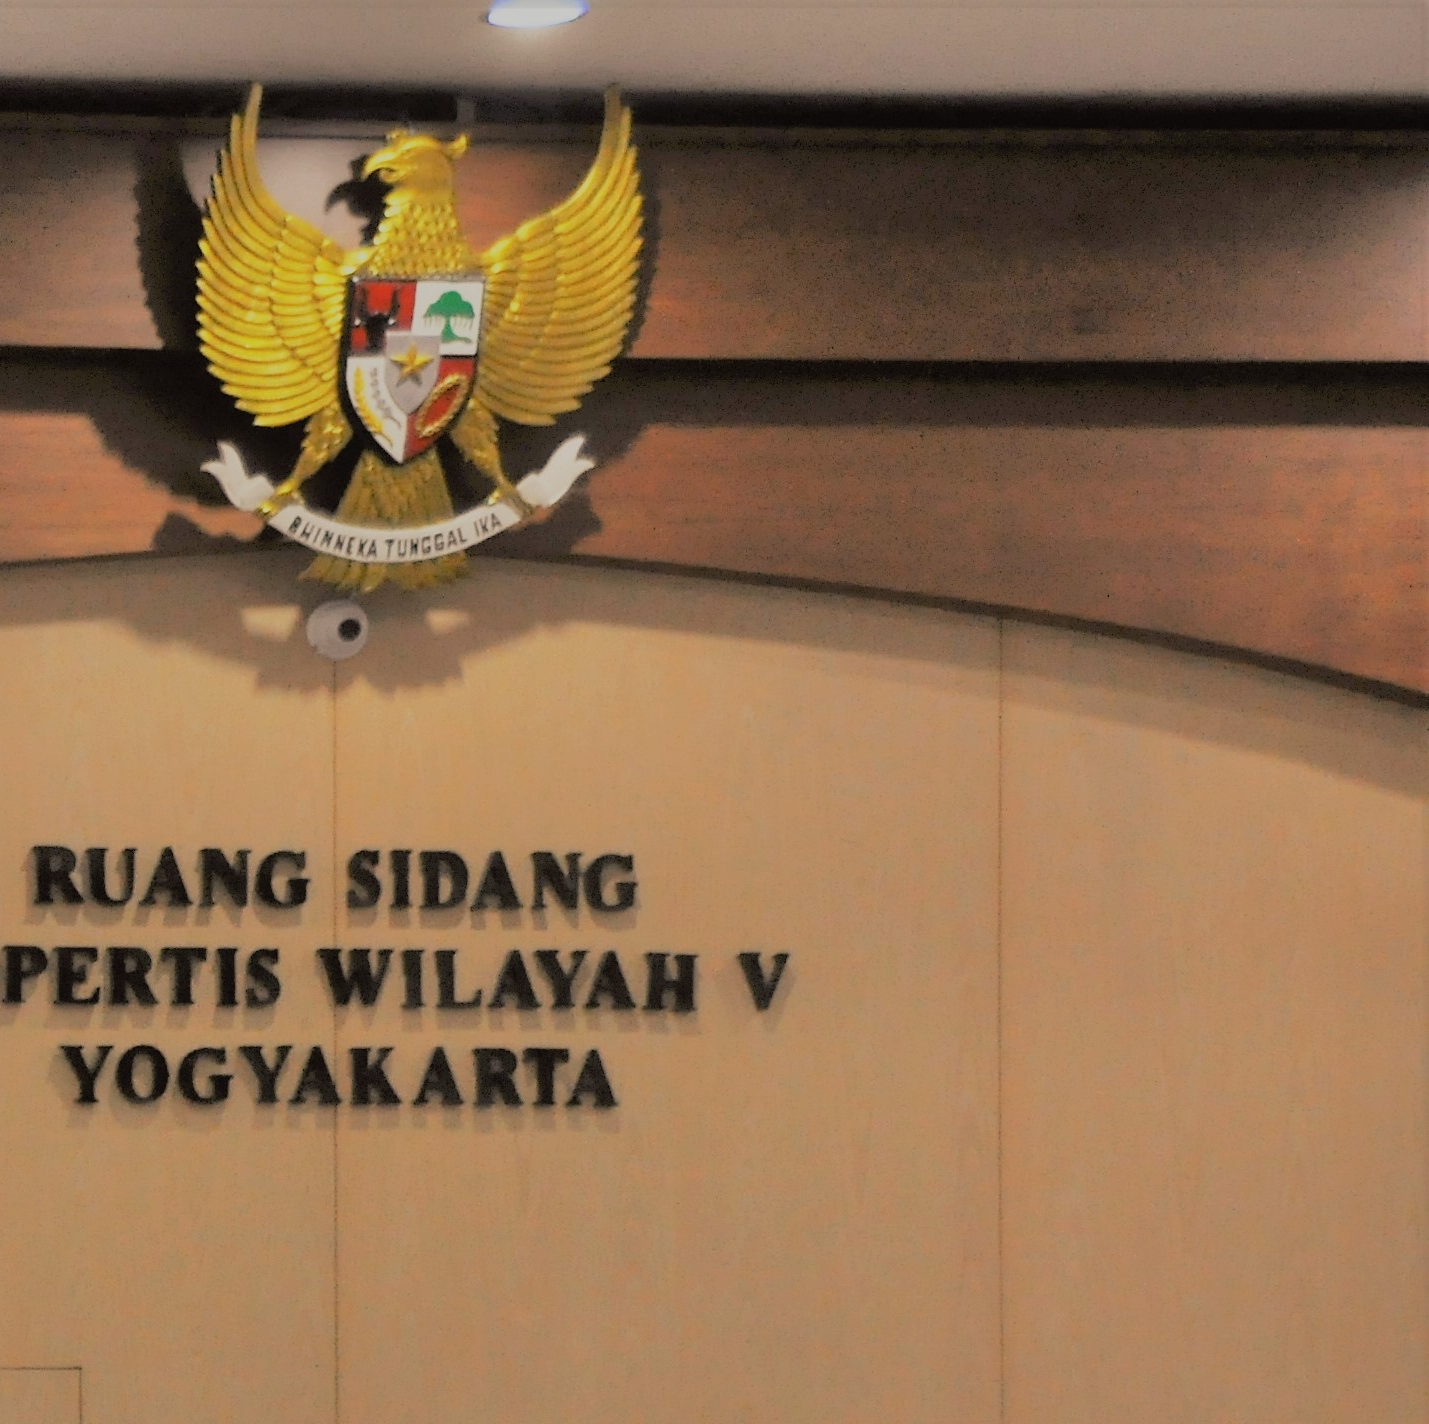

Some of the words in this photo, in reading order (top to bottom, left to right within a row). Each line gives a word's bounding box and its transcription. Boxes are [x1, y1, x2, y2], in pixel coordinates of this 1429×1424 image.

[385, 527, 468, 559] TUNGGAL
[474, 511, 503, 537] IKA
[32, 845, 311, 909] RUANG
[345, 848, 639, 912] SIDANG
[317, 947, 699, 1012] WILAYAH
[738, 951, 790, 1011] V
[61, 1044, 620, 1108] YOGYAKARTA
